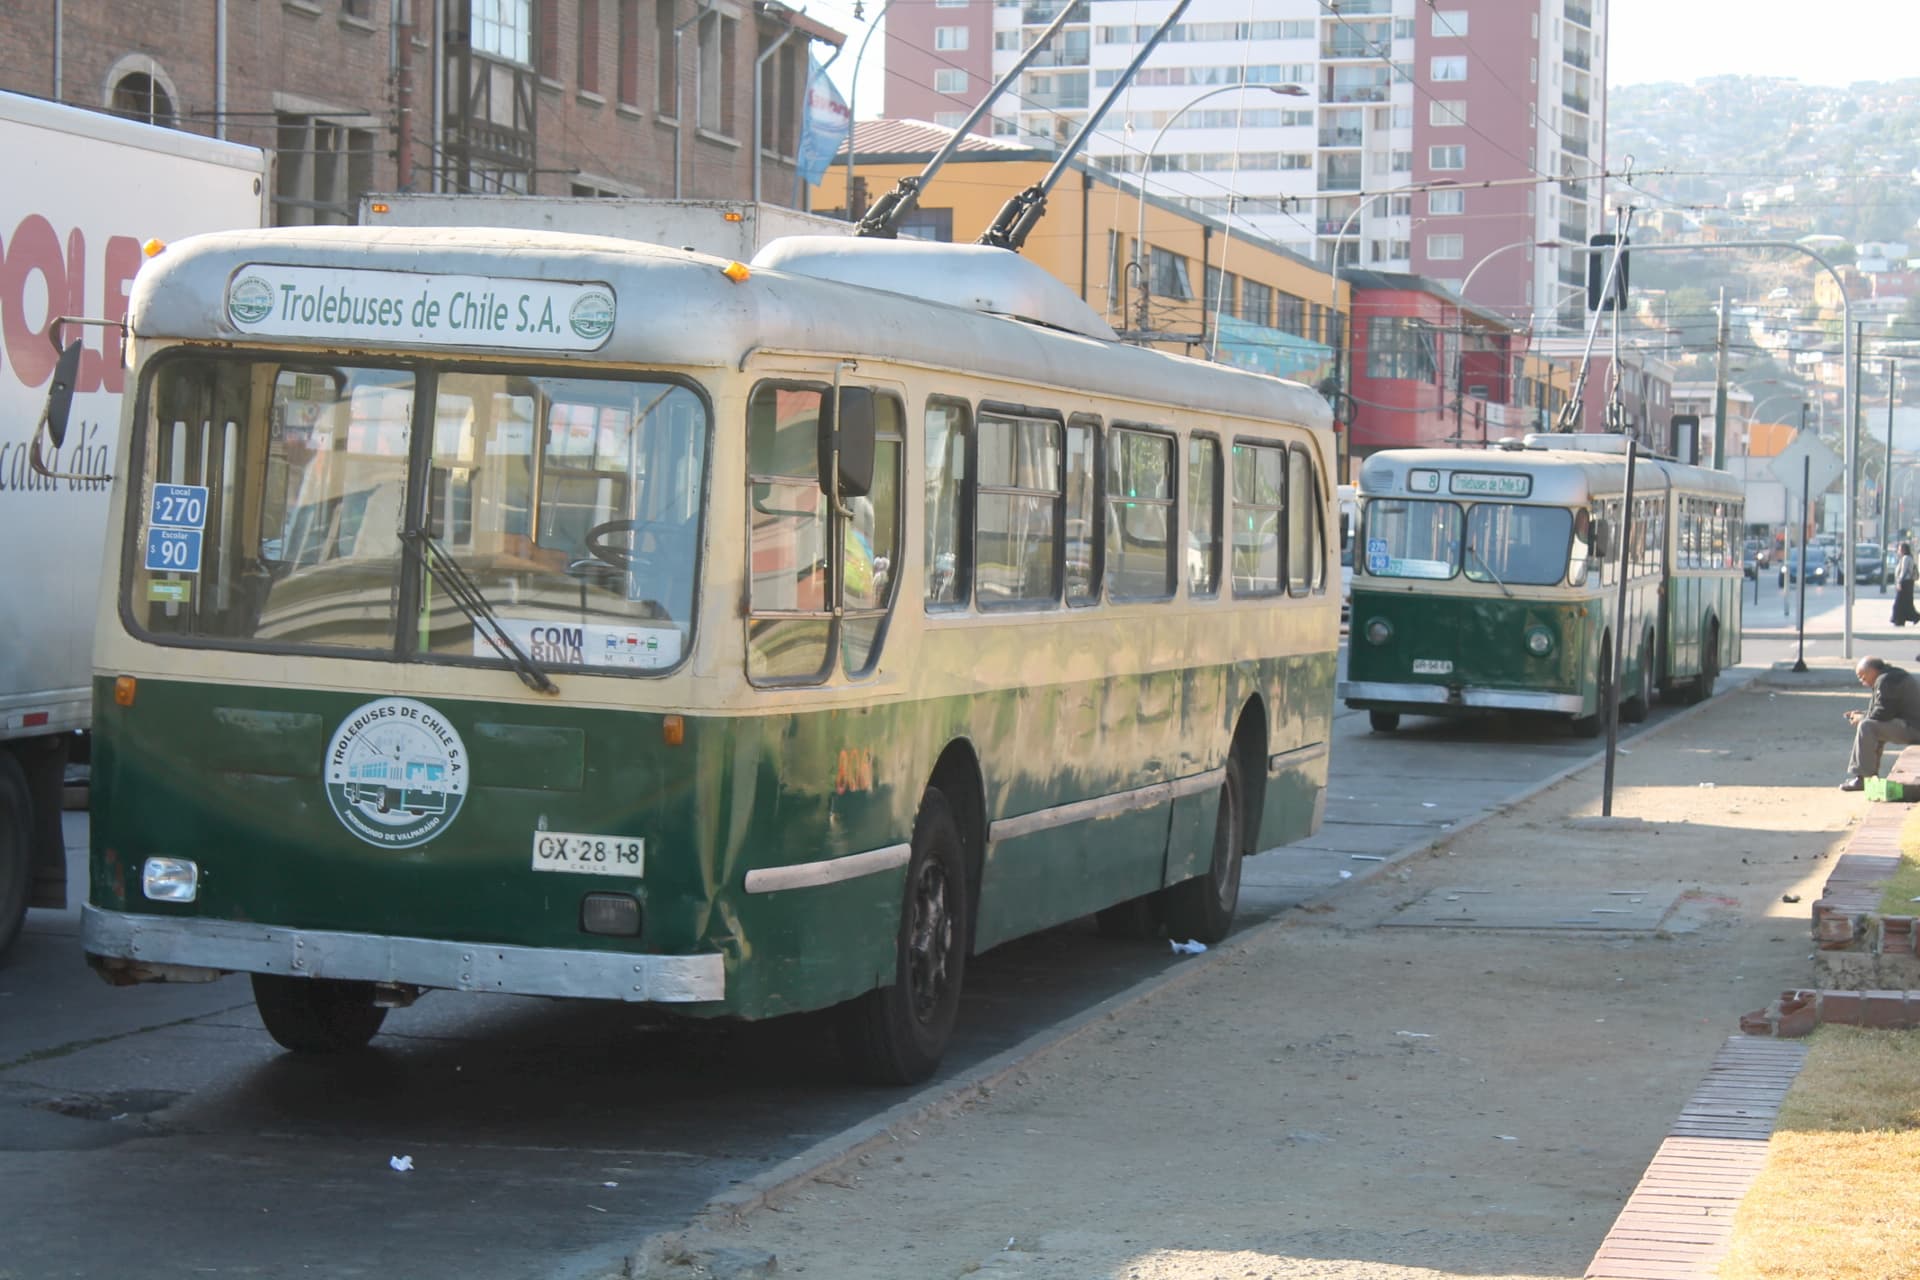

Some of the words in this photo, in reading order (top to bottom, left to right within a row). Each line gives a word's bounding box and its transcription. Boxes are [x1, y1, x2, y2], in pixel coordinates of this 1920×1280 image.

[280, 284, 404, 327] Trolebuses
[411, 289, 441, 329] de
[449, 291, 509, 331] Chile
[515, 294, 561, 335] S.A.
[69, 420, 108, 492] día
[1428, 474, 1437, 489] 8
[170, 487, 191, 497] Local
[161, 530, 188, 540] Escolar
[530, 627, 584, 647] COM
[332, 706, 396, 766] TROLEBUSES
[400, 706, 419, 720] DE
[421, 714, 454, 747] CHILE
[448, 749, 462, 776] S.A.
[384, 832, 396, 841] DE
